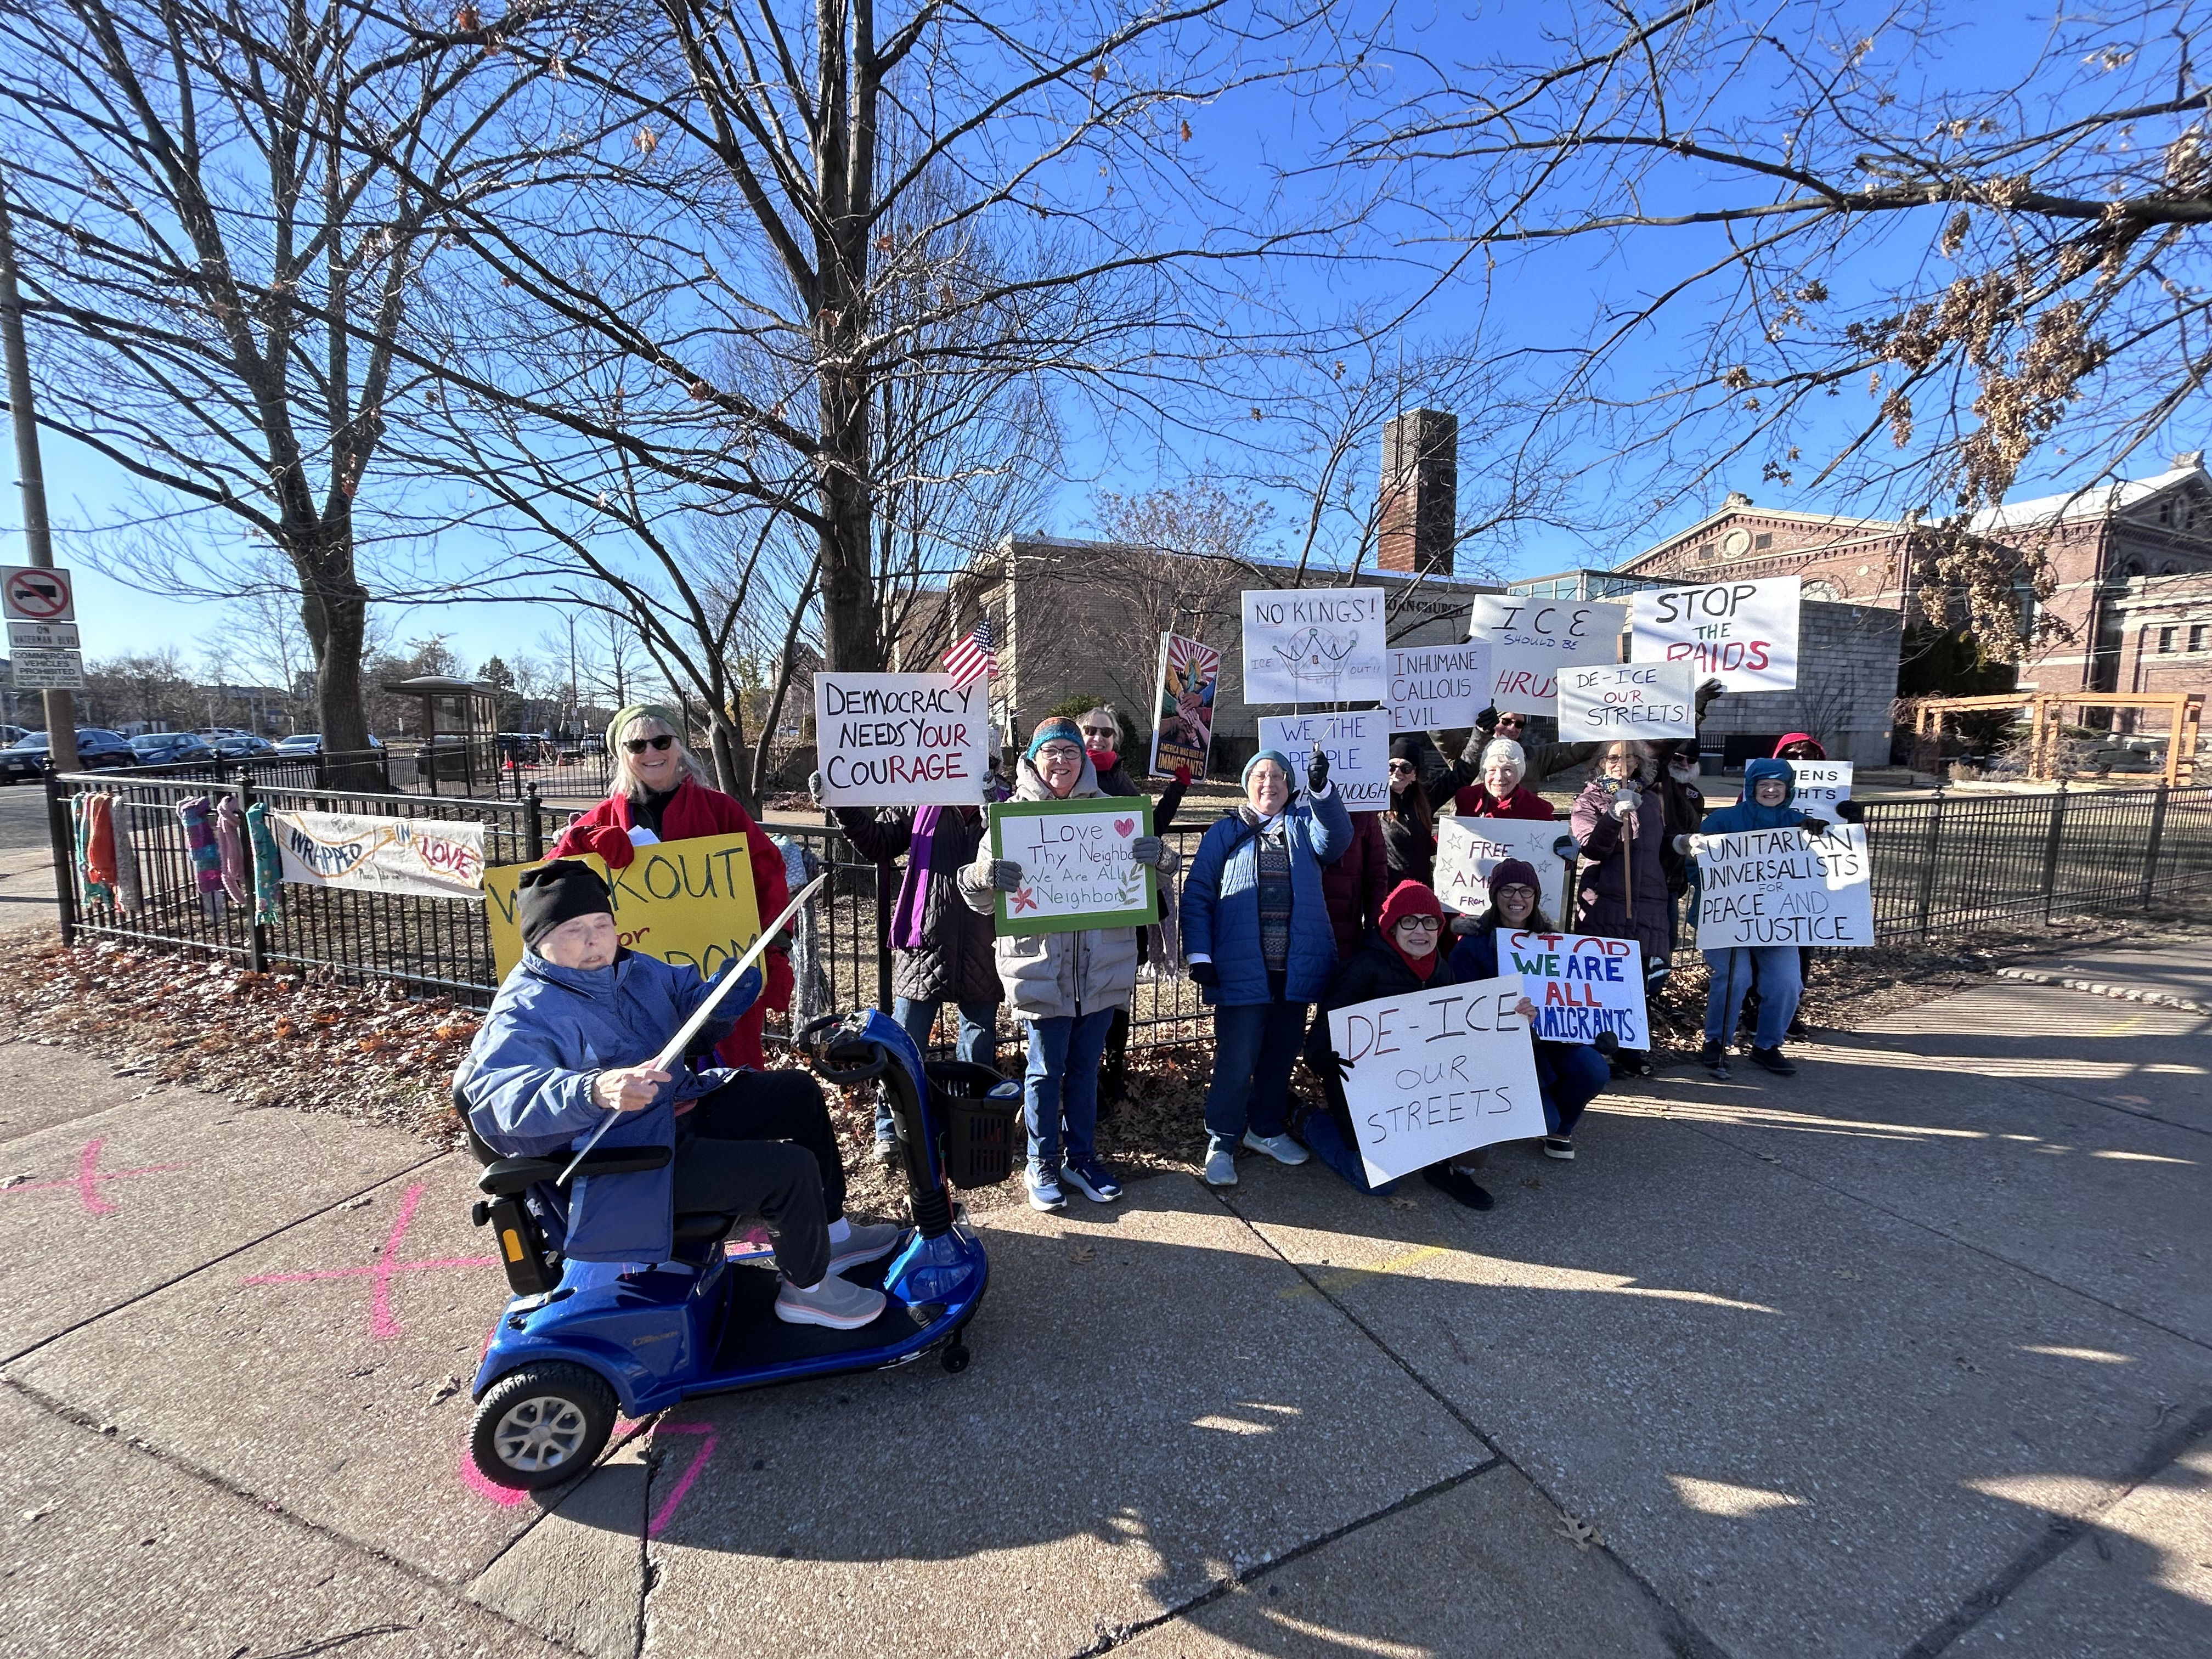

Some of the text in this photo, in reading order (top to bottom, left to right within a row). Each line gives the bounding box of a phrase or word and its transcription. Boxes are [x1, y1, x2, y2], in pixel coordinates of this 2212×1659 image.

[1256, 604, 1284, 624] NO
[1294, 598, 1375, 622] KINGS!
[1656, 585, 1756, 623] STOP
[1491, 607, 1592, 636] ICE
[1692, 623, 1731, 640] THE
[1504, 634, 1578, 650] SHOULD BE
[1251, 658, 1272, 670] ICE
[1394, 651, 1477, 676] INHUMANE
[1667, 641, 1771, 673] RAIDS
[1392, 679, 1471, 702] CALLOUS
[1576, 669, 1656, 688] DE-ICE
[826, 682, 973, 715] DEMOCRACY
[1604, 690, 1644, 703] OUR
[1395, 706, 1440, 727] EVIL
[1585, 704, 1690, 726] STREETS!
[839, 718, 971, 748] NEEDS YOUR
[1281, 717, 1366, 741] WE THE
[1160, 742, 1179, 754] AMERICA
[1180, 747, 1189, 757] WAS
[1289, 748, 1362, 771] PEPLE
[827, 752, 968, 788] COURAGE
[1040, 818, 1103, 843] Love
[290, 823, 479, 879] WRAPPED IN LOVE
[1028, 842, 1133, 870] Thy Neighbo
[1469, 841, 1514, 859] FREE
[1707, 828, 1853, 862] UNITARIAN
[1020, 866, 1052, 884] We
[1062, 868, 1088, 882] Are
[1699, 854, 1859, 891] UNIVERSALISTS
[1037, 884, 1126, 909] Neighbors
[1758, 882, 1784, 892] FOR
[1460, 896, 1485, 906] FROM
[1703, 891, 1829, 924] PEACE AND
[614, 921, 650, 947] or
[1735, 916, 1854, 943] JUSTICE
[1510, 952, 1624, 982] WE ARE
[1545, 981, 1602, 1007] ALL
[1348, 991, 1520, 1062] DE-ICE
[1532, 1006, 1635, 1042] MMIGRANTS
[1396, 1055, 1469, 1090] OUR
[1367, 1087, 1512, 1144] STREETS
